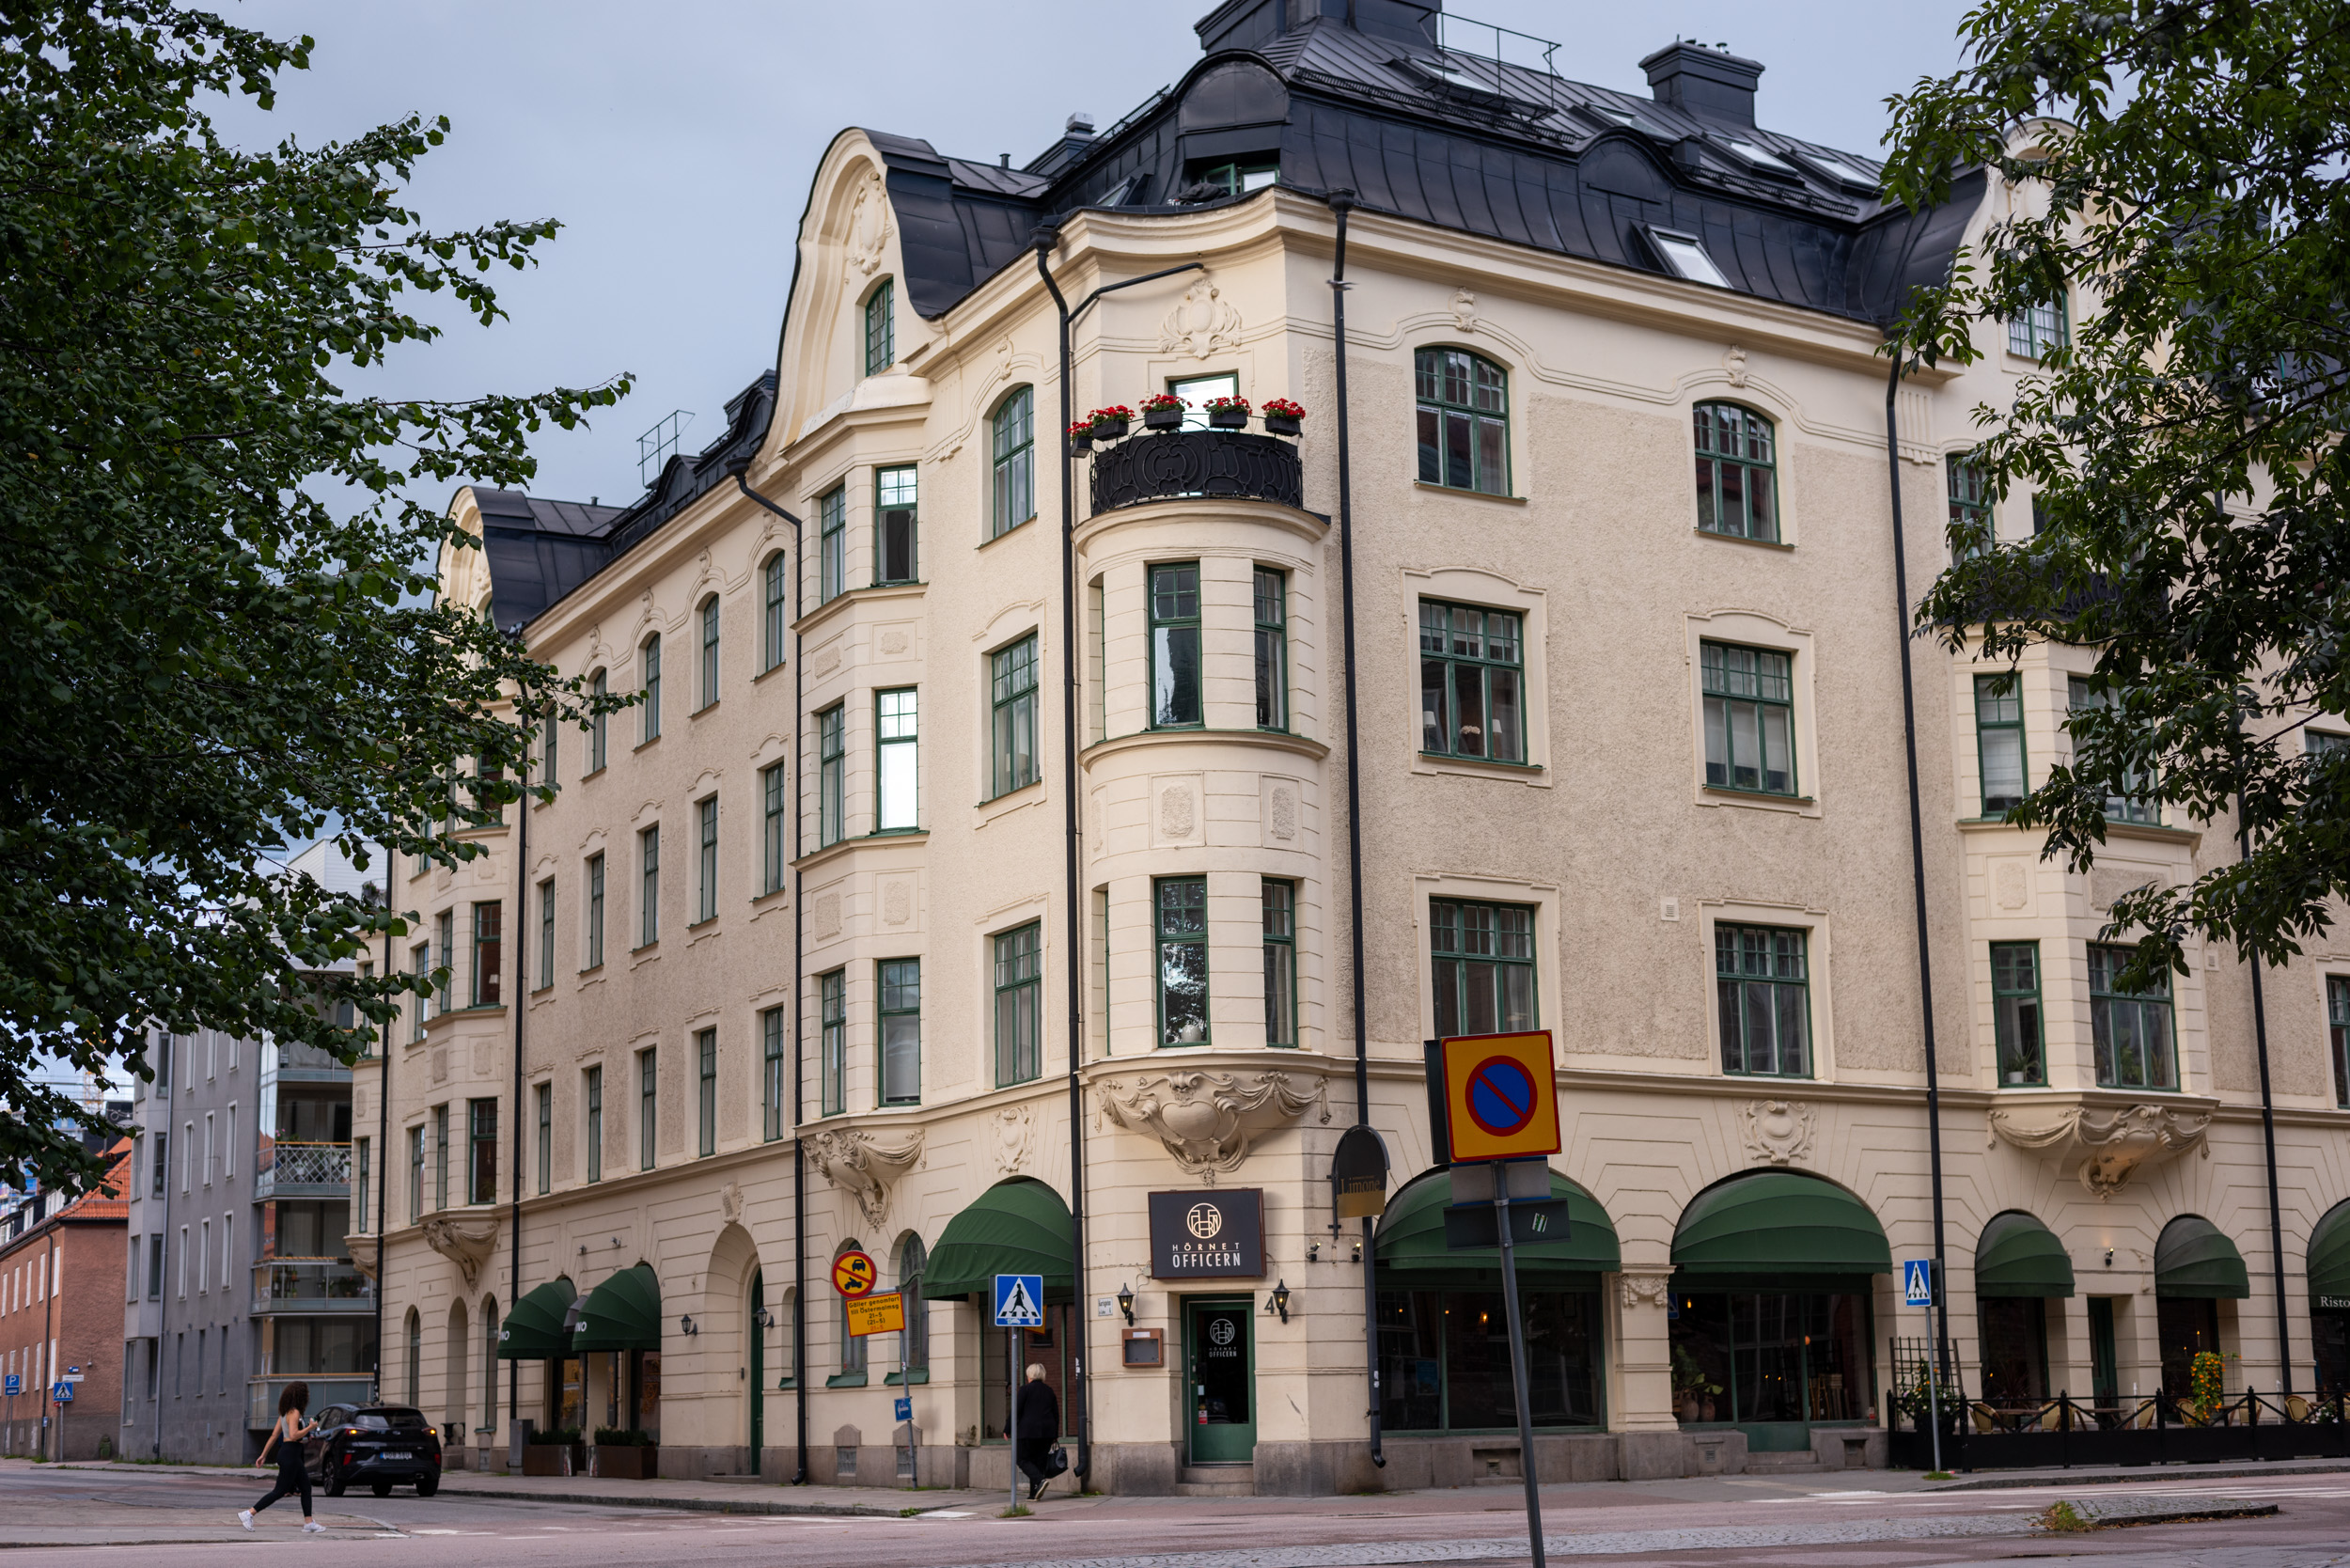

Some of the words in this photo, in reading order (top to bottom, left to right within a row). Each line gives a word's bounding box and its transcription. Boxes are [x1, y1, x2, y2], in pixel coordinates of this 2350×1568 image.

[1340, 1177, 1380, 1194] Limone
[1172, 1243, 1240, 1251] HÖRNET
[1172, 1253, 1241, 1268] OFFICERN
[1263, 1296, 1275, 1314] 4
[9, 1375, 17, 1386] P
